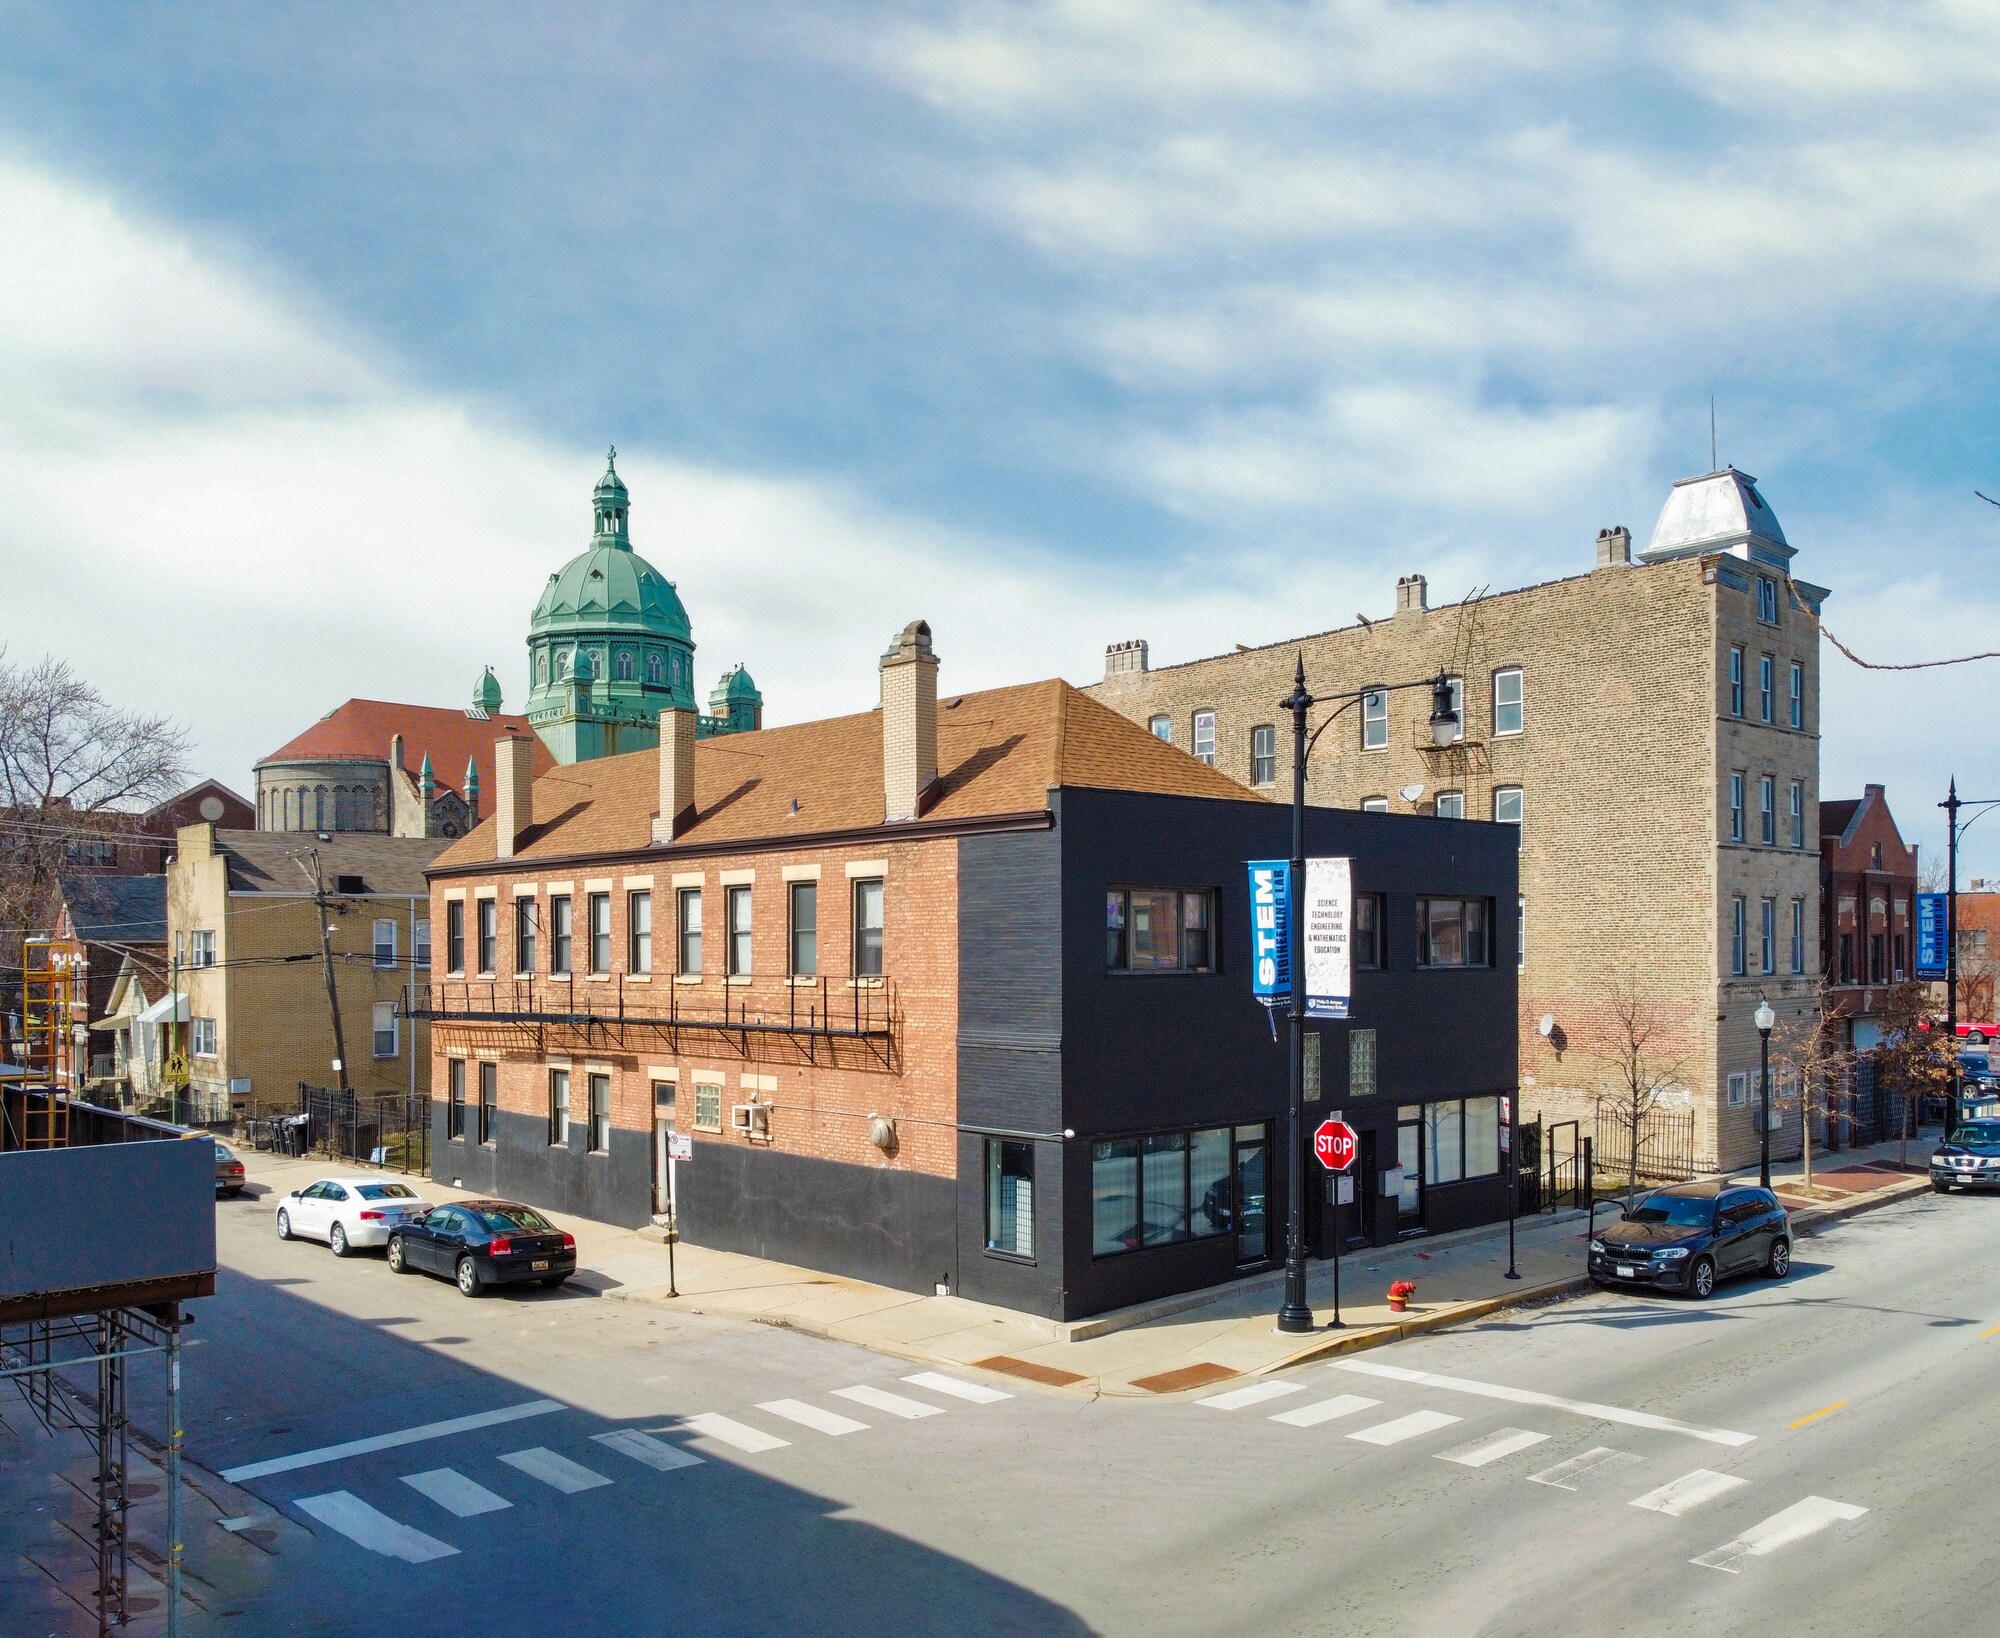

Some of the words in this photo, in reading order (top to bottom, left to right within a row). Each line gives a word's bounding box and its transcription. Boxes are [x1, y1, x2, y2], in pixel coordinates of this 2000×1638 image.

[1274, 869, 1285, 893] LAB
[1311, 911, 1343, 919] TECHNOLOGY
[1254, 870, 1275, 986] STEM
[1308, 934, 1313, 942] &
[1313, 934, 1347, 942] MATHEMATICS
[1920, 898, 1934, 965] STEM
[1275, 898, 1290, 984] ENGINEERING
[1314, 945, 1341, 954] EDUCATION
[1318, 1135, 1352, 1155] STOP
